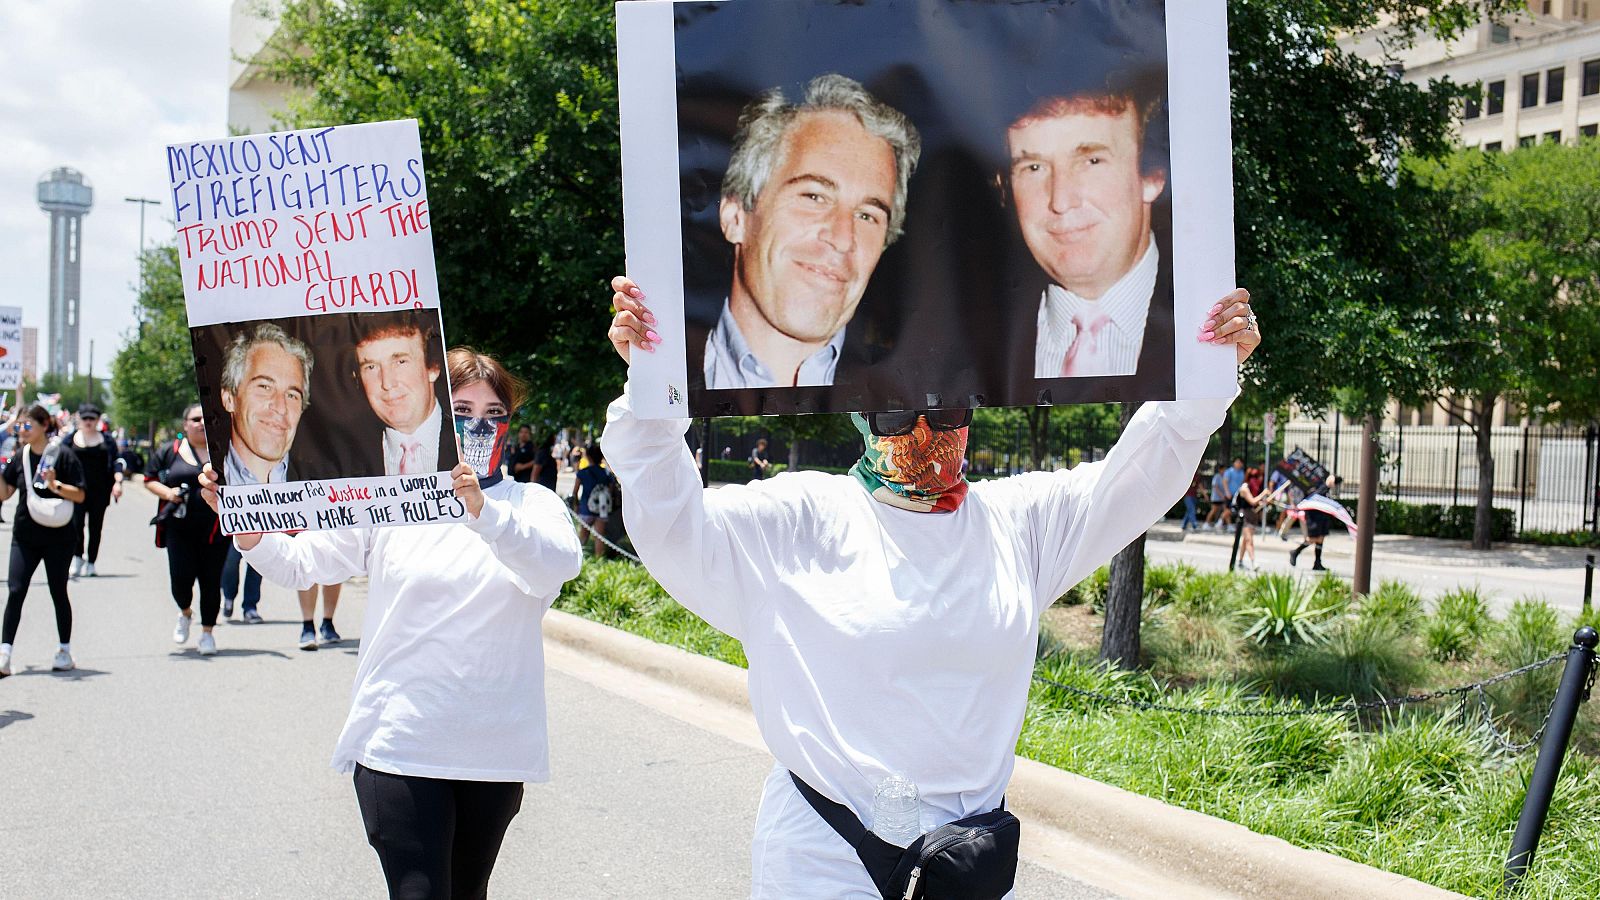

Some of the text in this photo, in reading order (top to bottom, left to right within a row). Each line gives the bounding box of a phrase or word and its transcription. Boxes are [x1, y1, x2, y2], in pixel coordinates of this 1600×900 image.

[166, 127, 335, 184] MEXICO SENT
[173, 158, 422, 223] FIREFIGHTERS
[177, 200, 429, 259] TRUMP SENT THE
[197, 249, 347, 291] NATIONAL
[304, 268, 424, 313] GUARD!
[221, 496, 466, 534] CRIMINALS MAKE THE RULES
[247, 488, 274, 506] will
[274, 489, 304, 506] never
[328, 484, 372, 504] Justice
[374, 485, 387, 499] in
[389, 486, 398, 497] a
